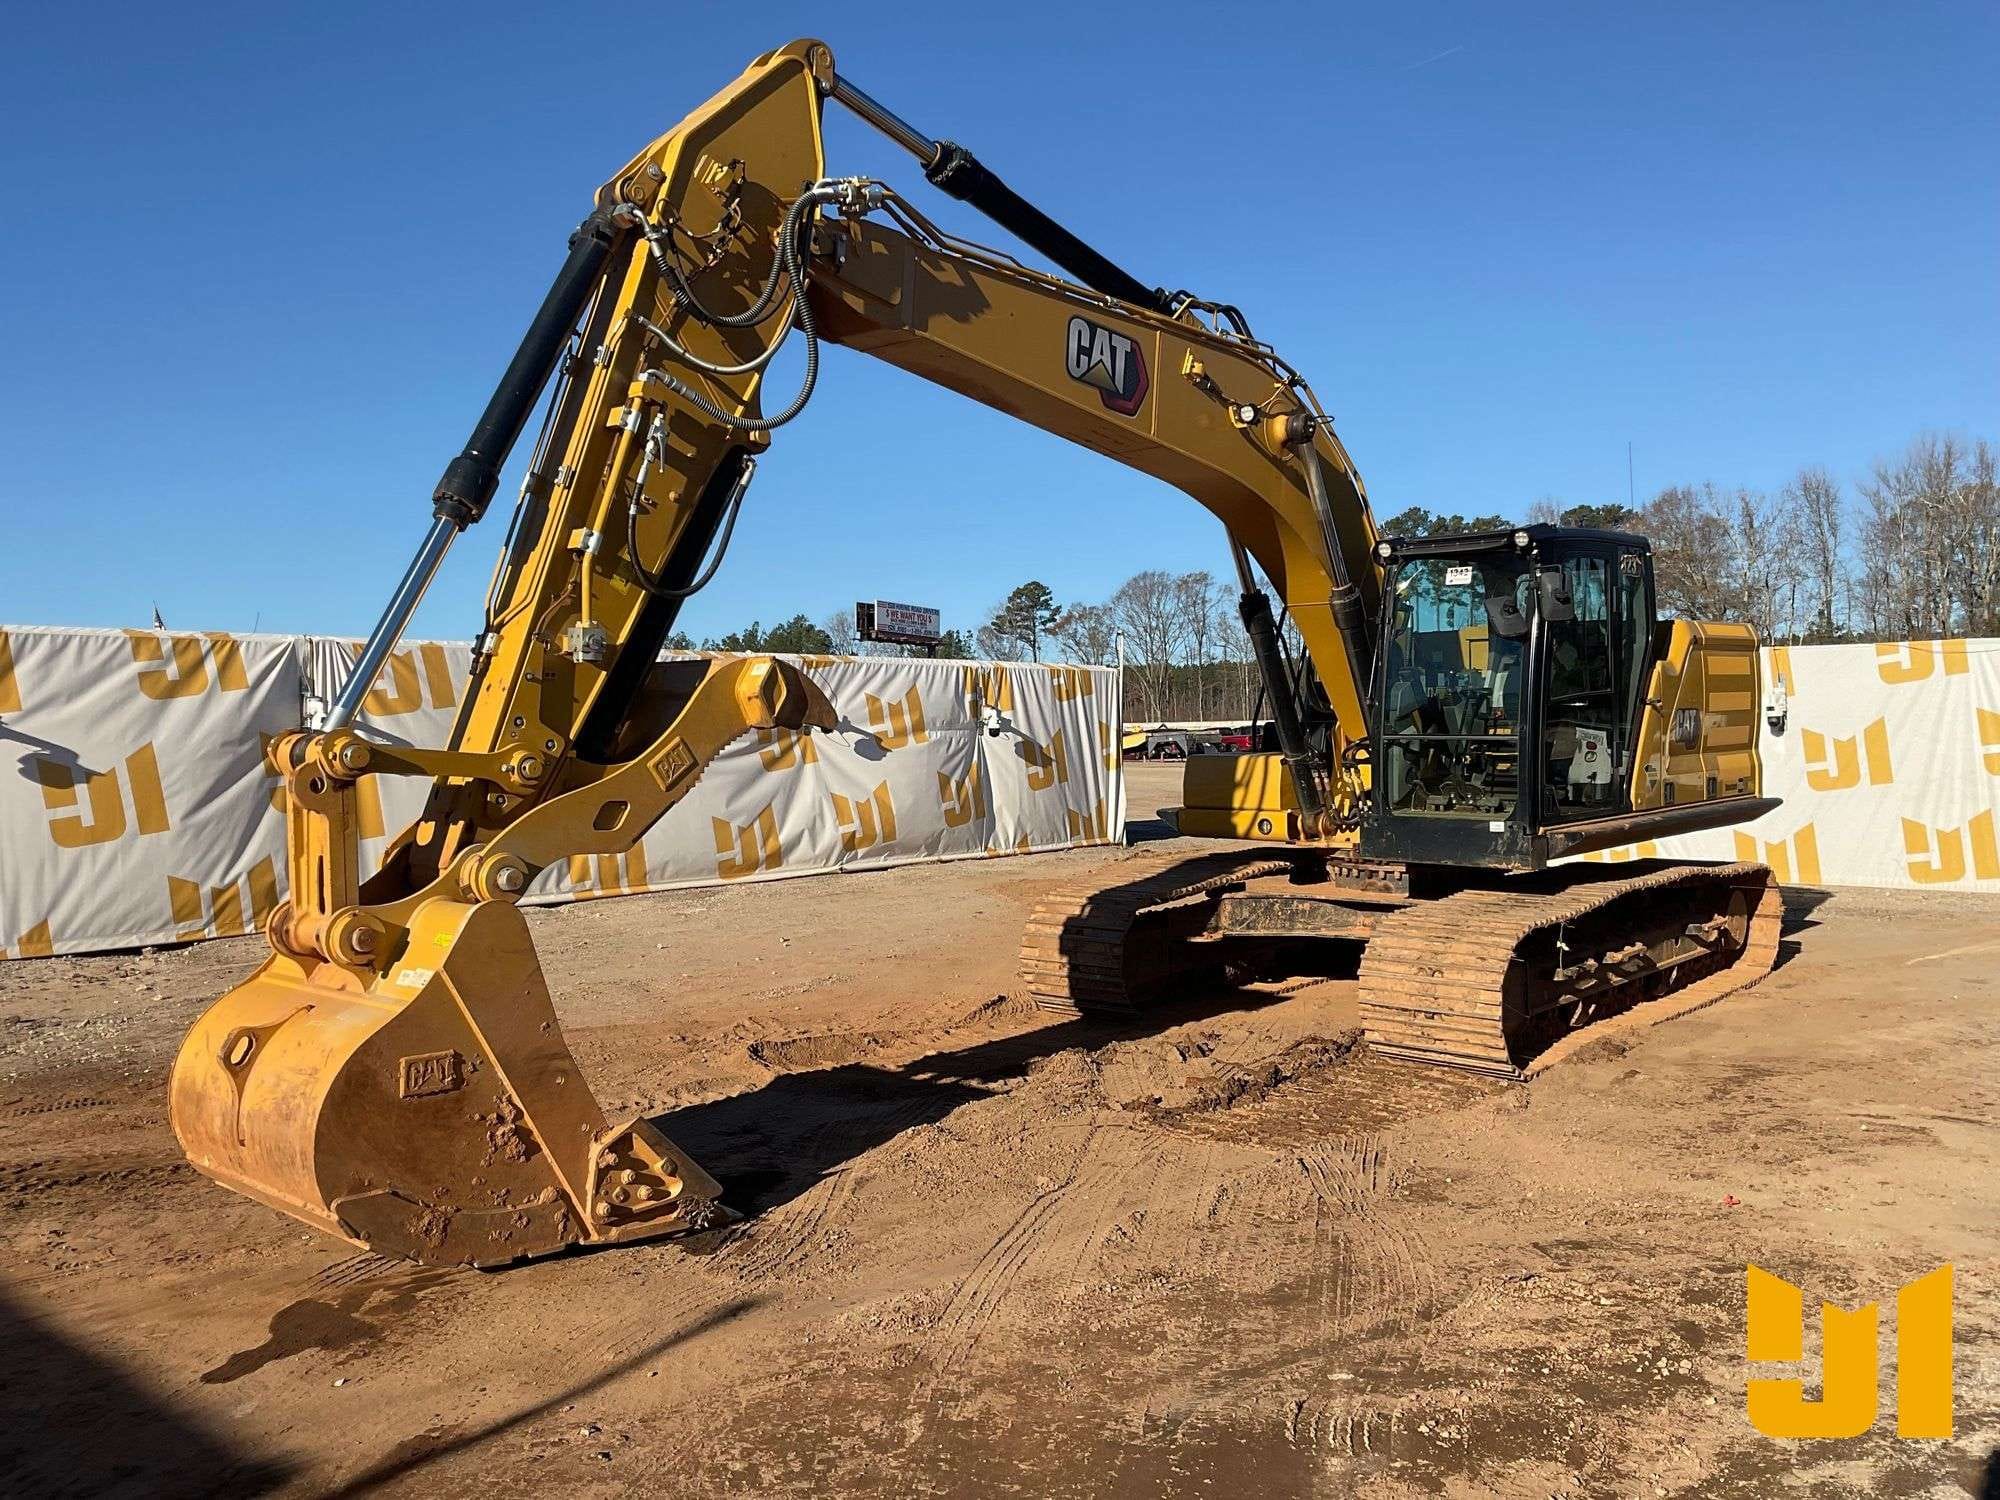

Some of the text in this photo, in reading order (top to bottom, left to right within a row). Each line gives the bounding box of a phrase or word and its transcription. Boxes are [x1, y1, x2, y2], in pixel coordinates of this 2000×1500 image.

[1068, 318, 1131, 394] CAT
[1676, 709, 1697, 742] CAT
[657, 744, 690, 783] CAT
[407, 1057, 455, 1091] CAT
